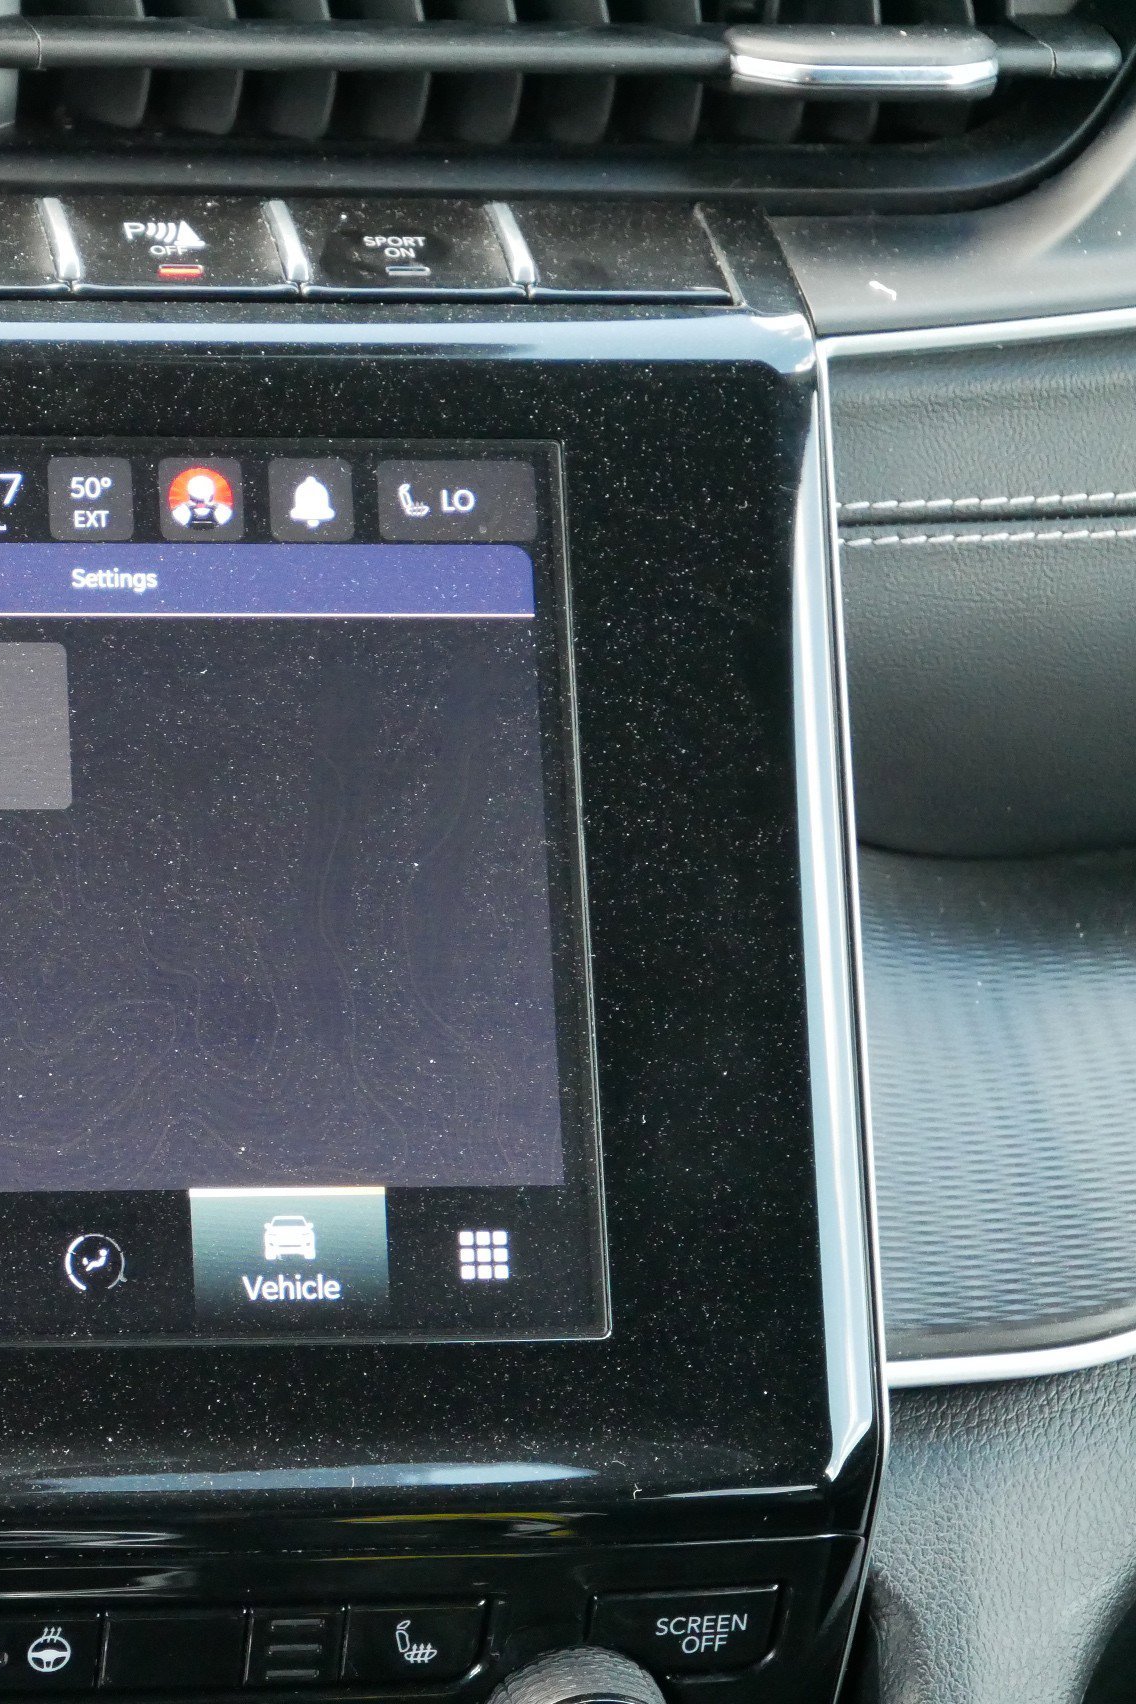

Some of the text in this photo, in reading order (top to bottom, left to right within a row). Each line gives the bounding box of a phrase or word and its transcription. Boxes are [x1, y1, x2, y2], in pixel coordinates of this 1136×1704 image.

[123, 222, 145, 240] P
[149, 245, 188, 255] OFF
[363, 236, 426, 247] SPORT
[384, 247, 416, 258] ON
[69, 476, 113, 500] 50°
[440, 488, 477, 512] LO
[73, 509, 110, 529] EXT
[70, 567, 159, 593] Settings
[241, 1274, 341, 1301] Vehicle
[655, 1613, 749, 1636] SCREEN
[681, 1634, 728, 1654] OFF
